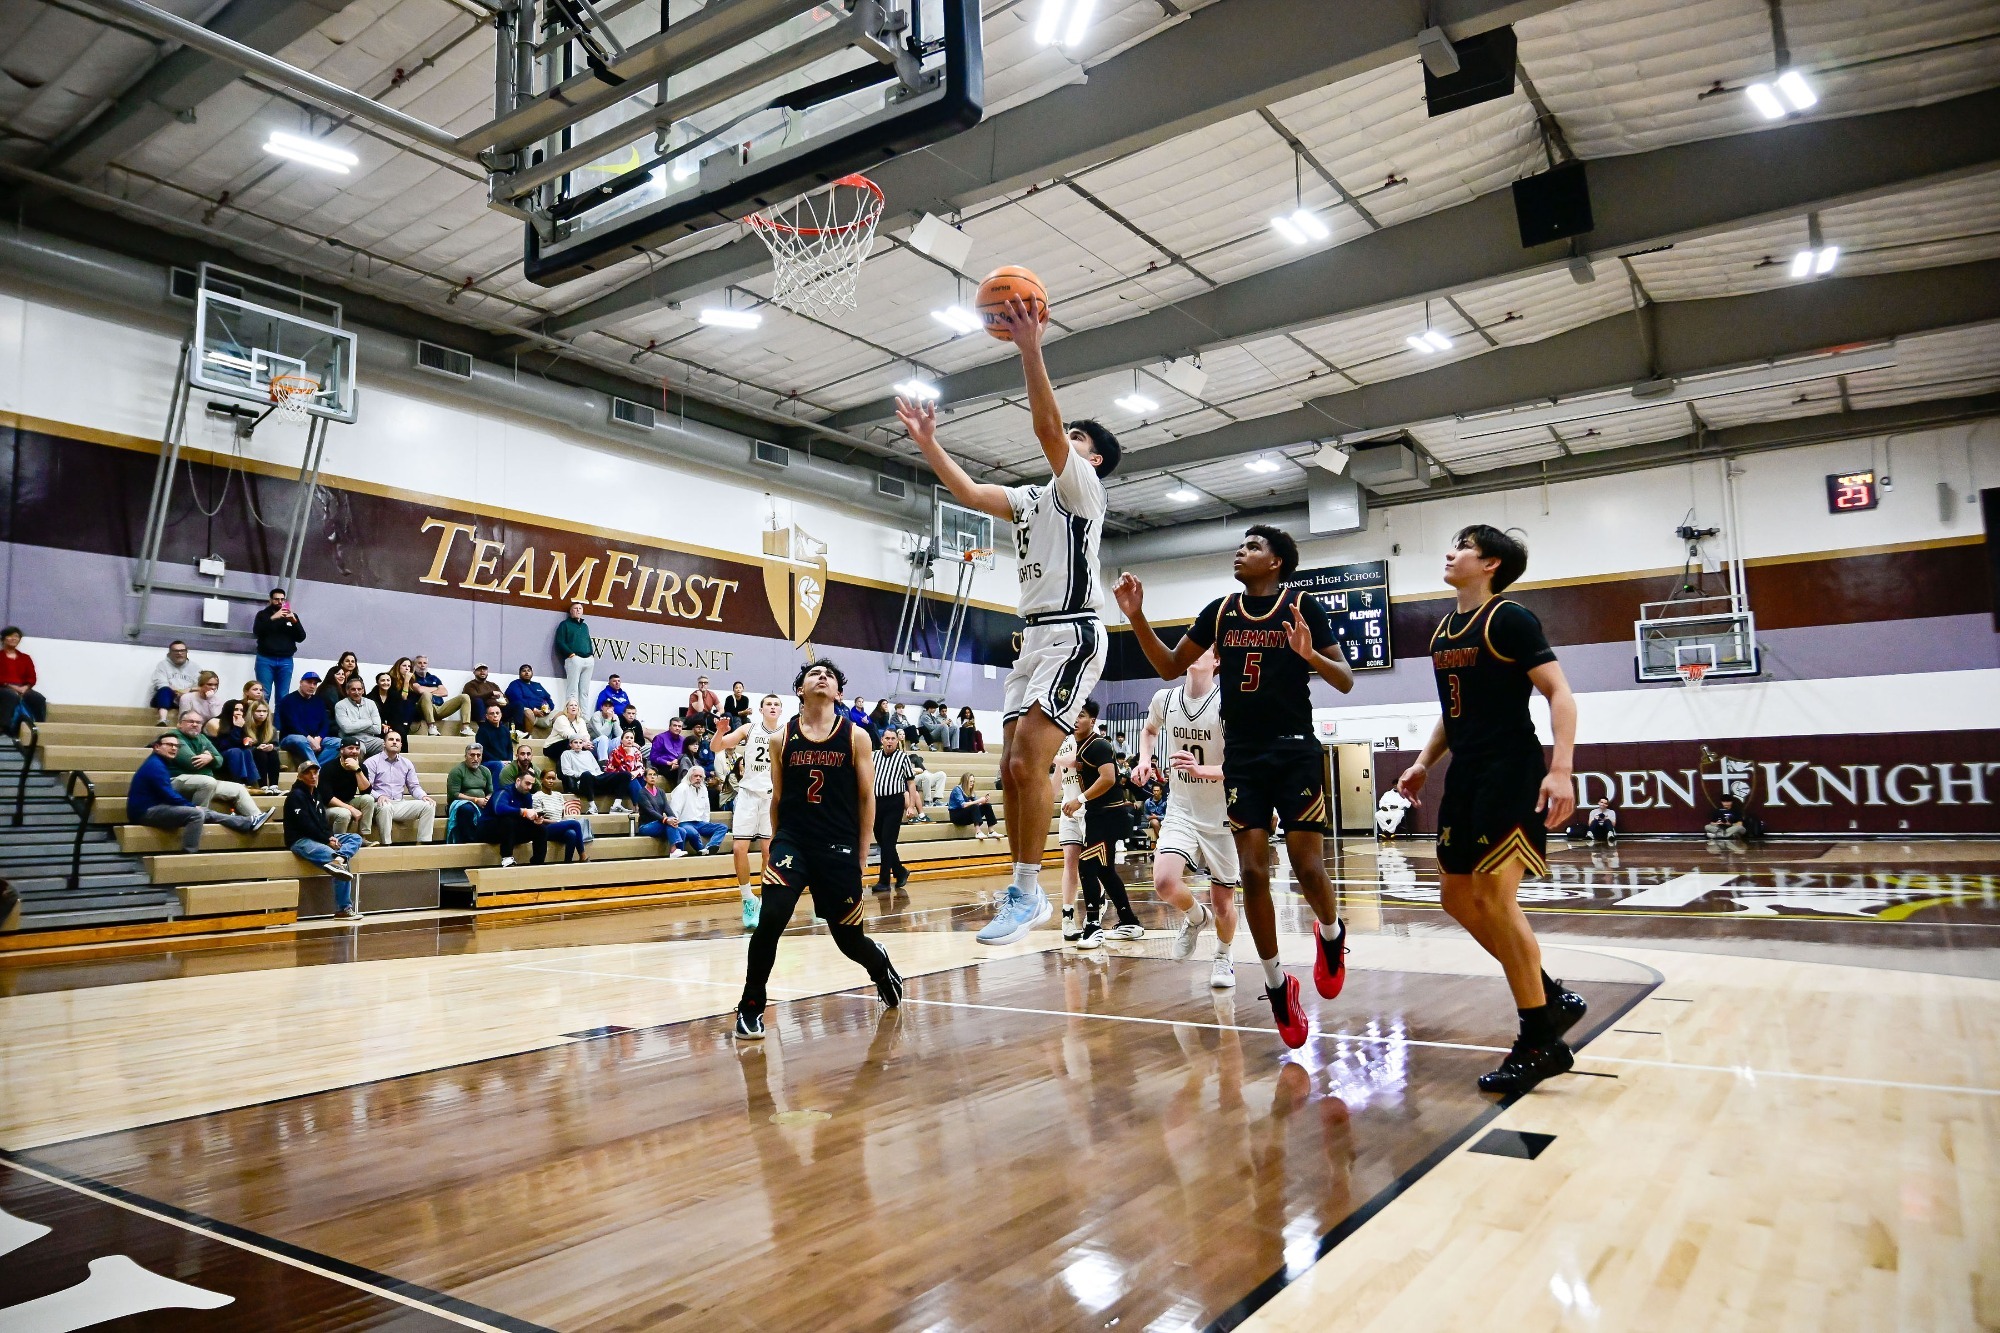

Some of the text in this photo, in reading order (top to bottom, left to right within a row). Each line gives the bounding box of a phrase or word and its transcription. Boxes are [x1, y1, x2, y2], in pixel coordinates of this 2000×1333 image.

[1837, 485, 1869, 507] 23
[1315, 574, 1341, 585] HIGH
[1343, 571, 1381, 582] SCHOOL
[1349, 608, 1382, 620] ALEMANY
[1364, 619, 1381, 637] 16
[1223, 629, 1288, 649] ALEMANY
[591, 637, 734, 671] WW.SFHS.NET
[1350, 646, 1359, 660] 3
[1372, 644, 1382, 658] 0
[1240, 652, 1262, 692] 5
[1448, 674, 1461, 718] 3
[1173, 726, 1212, 741] GOLDEN
[789, 750, 846, 767] ALEMANY
[807, 769, 825, 804] 2
[1571, 769, 1698, 809] DEN
